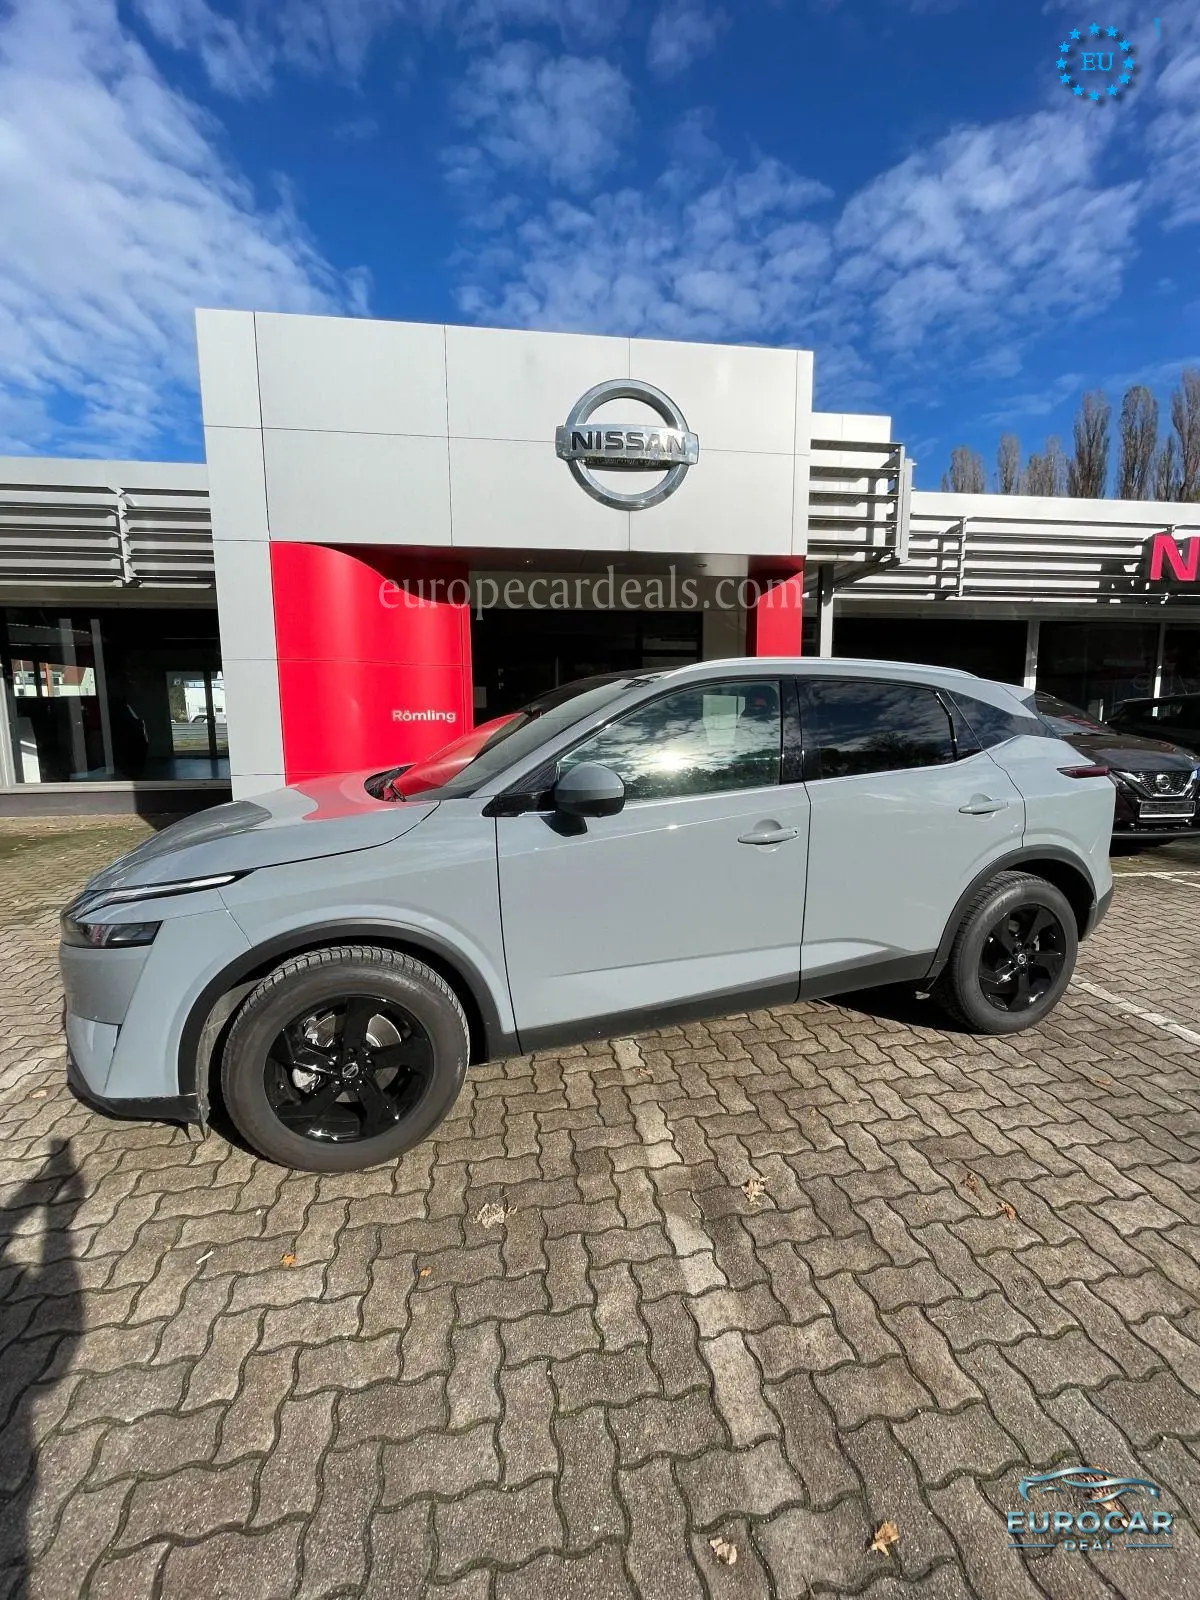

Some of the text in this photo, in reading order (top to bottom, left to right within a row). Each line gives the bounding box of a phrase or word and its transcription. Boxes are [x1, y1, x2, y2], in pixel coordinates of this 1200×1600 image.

[571, 431, 686, 456] NISSAN
[1150, 534, 1200, 581] N
[391, 708, 457, 724] Römling
